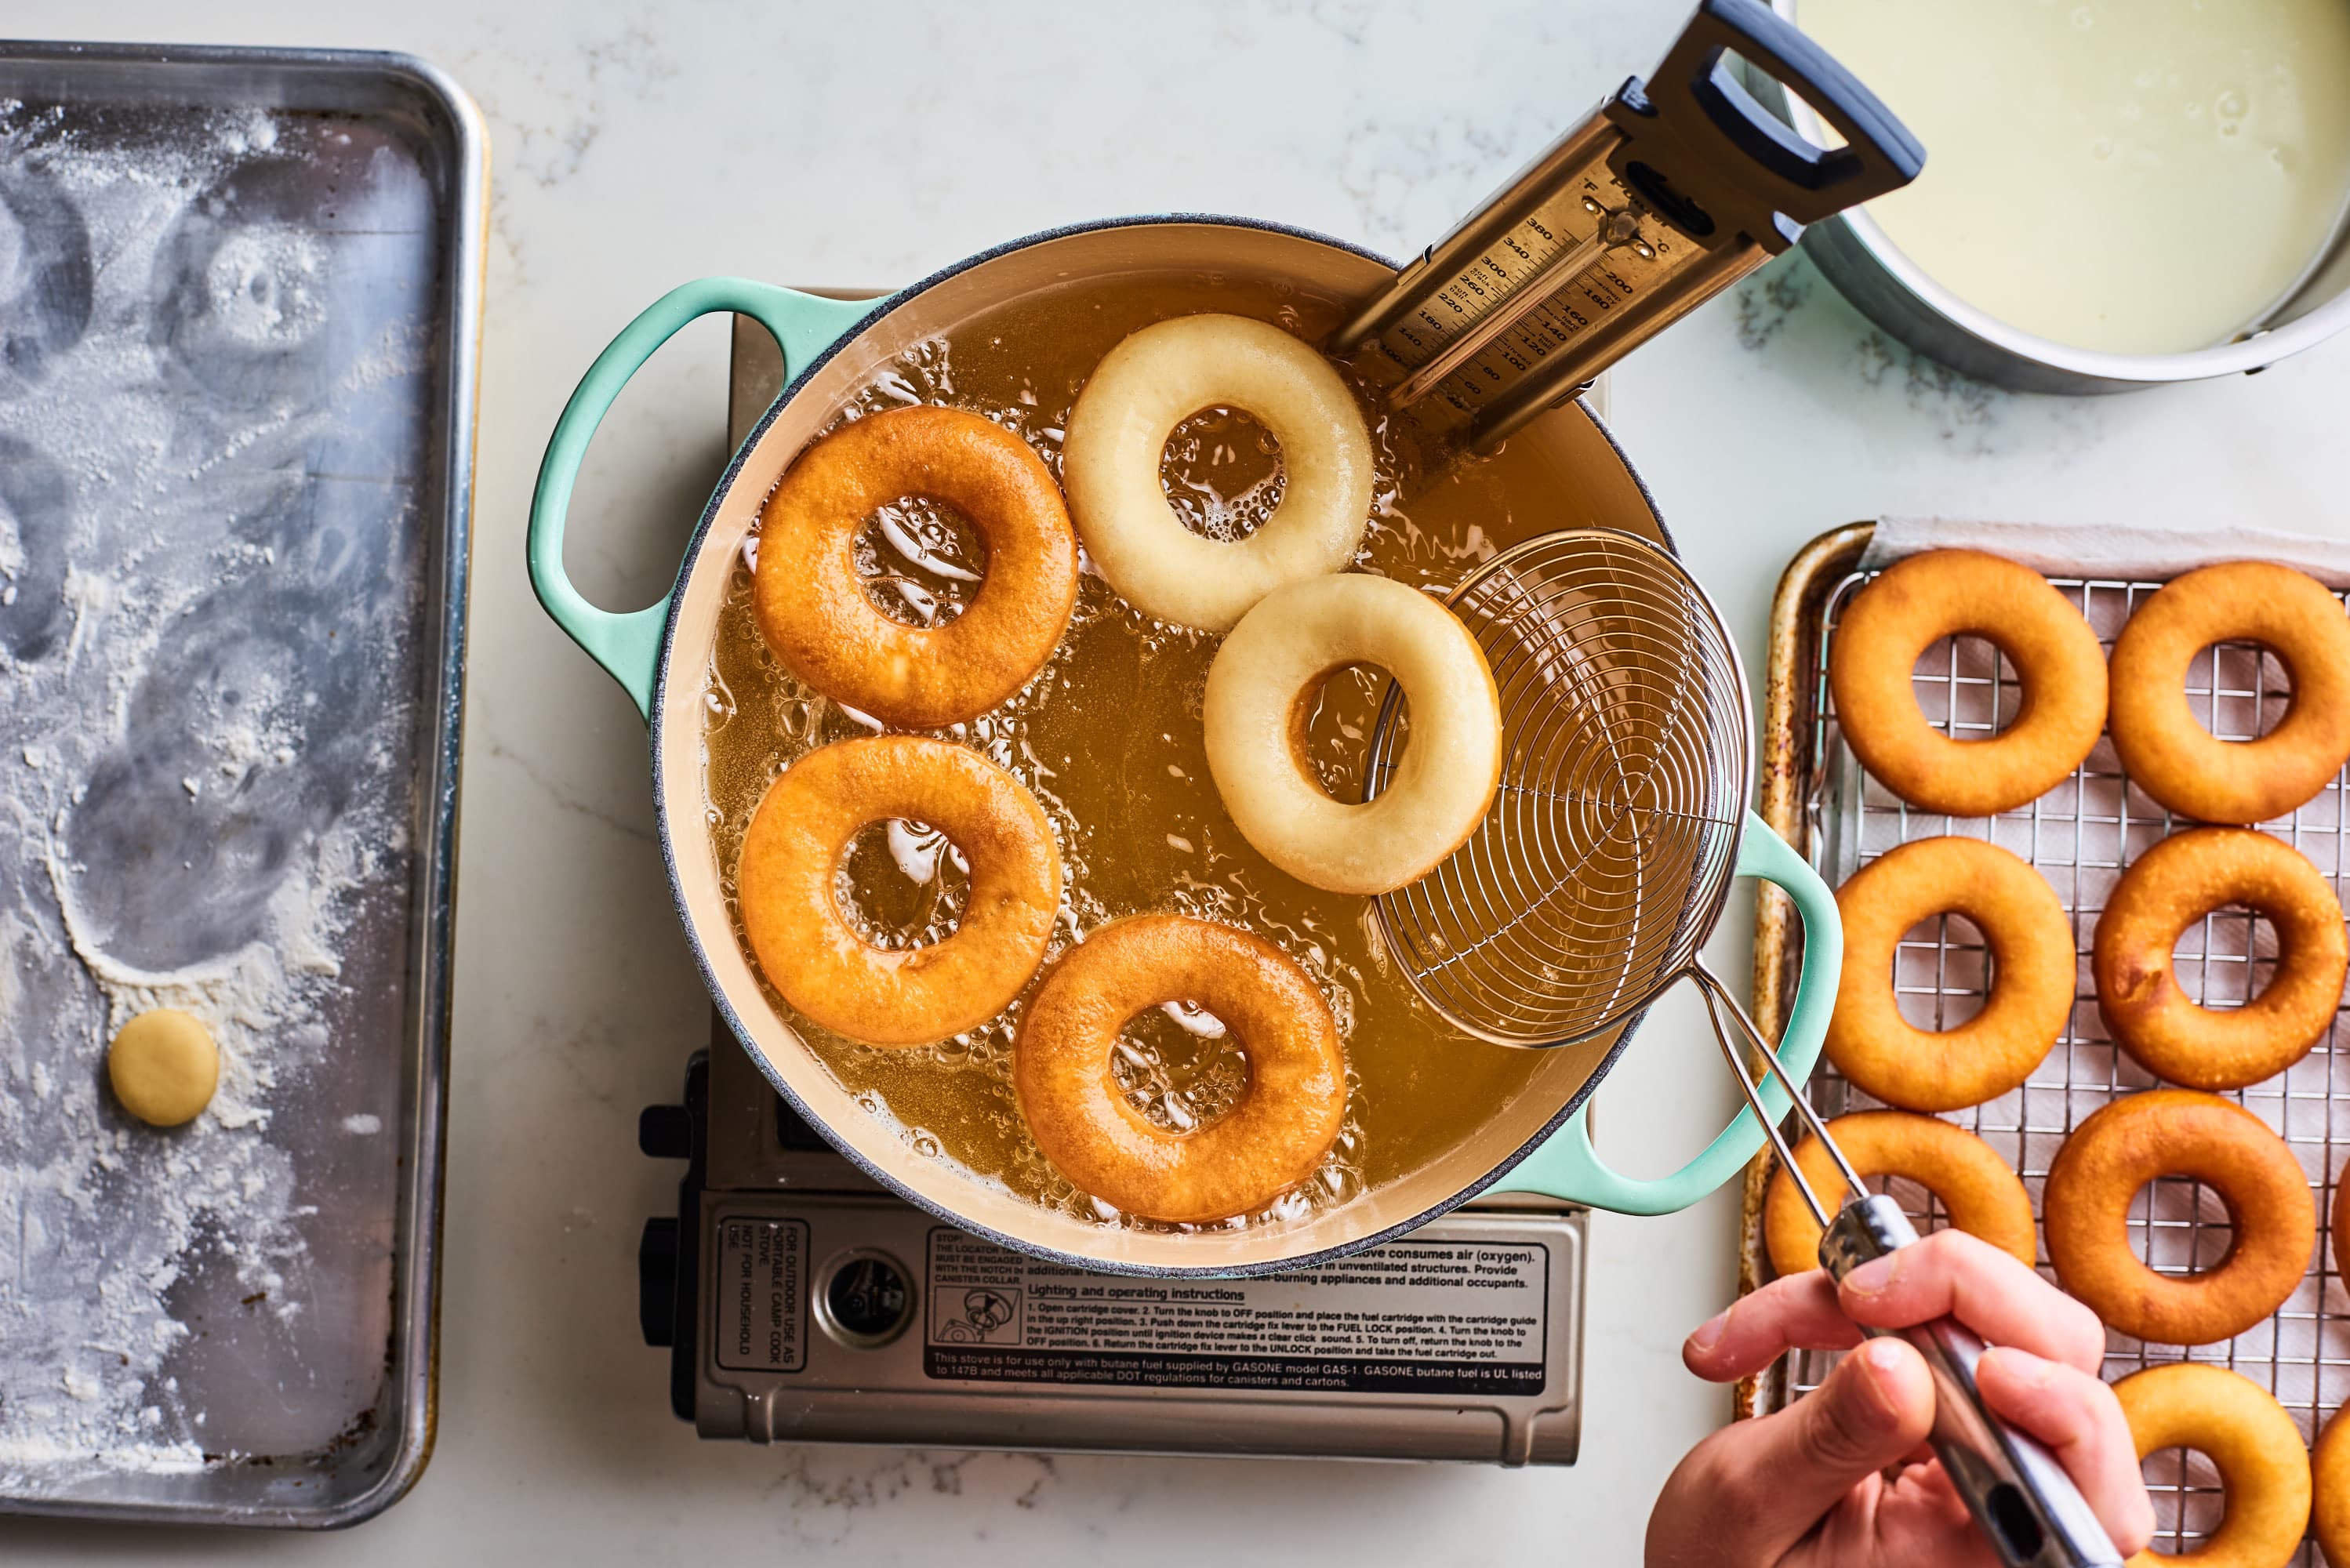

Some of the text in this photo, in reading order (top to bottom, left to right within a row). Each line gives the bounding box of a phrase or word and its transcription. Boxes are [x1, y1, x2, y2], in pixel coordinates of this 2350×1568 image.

[1527, 218, 1553, 240] 380
[1503, 238, 1529, 259] 340
[1481, 256, 1507, 278] 300
[1459, 275, 1484, 296] 260
[1606, 271, 1633, 293] 200
[1438, 292, 1463, 313] 220
[1584, 289, 1610, 309] 180
[1418, 310, 1442, 329] 180
[1562, 305, 1588, 325] 160
[1399, 327, 1422, 347] 140
[1542, 321, 1567, 341] 140
[1521, 336, 1546, 356] 120
[1502, 352, 1526, 371] 100
[1388, 1249, 1535, 1264] consumes air (oxygen).
[1338, 1260, 1407, 1272] unventilated
[1473, 1264, 1517, 1275] Provide
[739, 1225, 752, 1355] NOT FOR HOUSEHOLD
[1320, 1274, 1382, 1287] appliances
[1384, 1275, 1406, 1285] and
[1408, 1276, 1463, 1287] additional
[769, 1226, 783, 1363] PORTABLE CAMP COOK
[783, 1227, 797, 1363] FOR OUTDOOR USE AS
[1027, 1285, 1244, 1300] Lighting and operating instructions
[1037, 1304, 1063, 1314] Open
[1066, 1305, 1109, 1315] cartridge
[1193, 1308, 1219, 1316] knob
[1255, 1309, 1293, 1320] position
[1316, 1311, 1342, 1321] place
[1343, 1312, 1359, 1320] the
[1381, 1313, 1424, 1323] cartridge
[1465, 1315, 1508, 1326] cartridge
[1509, 1316, 1537, 1327] guide
[1044, 1327, 1088, 1335] IGNITION
[1090, 1328, 1129, 1338] position
[1154, 1330, 1191, 1340] ignition
[1193, 1330, 1225, 1339] device
[1226, 1331, 1257, 1340] makes
[1420, 1337, 1449, 1345] return
[1070, 1316, 1093, 1326] right
[1150, 1318, 1174, 1327] Push
[1176, 1319, 1203, 1327] down
[1204, 1319, 1221, 1328] the
[1222, 1320, 1266, 1330] cartridge
[1490, 1327, 1514, 1336] knob
[1026, 1337, 1045, 1345] OFF
[1103, 1339, 1135, 1348] Return
[1155, 1341, 1198, 1352] cartridge
[1214, 1342, 1237, 1351] lever
[1269, 1344, 1311, 1353] UNLOCK
[1313, 1345, 1353, 1356] position
[1375, 1347, 1396, 1356] take
[1434, 1349, 1477, 1359] cartridge
[935, 1352, 957, 1363] This
[961, 1353, 990, 1363] stove
[1006, 1355, 1020, 1364] for
[1047, 1356, 1070, 1368] only
[1074, 1357, 1097, 1367] with
[1100, 1358, 1139, 1368] butane
[1142, 1359, 1162, 1369] fuel
[1166, 1359, 1212, 1372] supplied
[1232, 1361, 1281, 1372] GASONE
[1285, 1363, 1319, 1373] model
[1364, 1365, 1413, 1376] GASONE
[1415, 1367, 1455, 1377] butane
[1457, 1368, 1477, 1377] fuel
[1493, 1369, 1508, 1378] UL
[1511, 1370, 1542, 1379] listed
[951, 1365, 978, 1375] 147B
[980, 1366, 1001, 1376] and
[1004, 1367, 1037, 1377] meets
[1041, 1368, 1054, 1377] all
[1056, 1368, 1113, 1381] applicable
[1116, 1370, 1139, 1380] DOT
[1143, 1371, 1206, 1384] regulations
[1208, 1373, 1224, 1382] for
[1227, 1374, 1278, 1385] canisters
[1280, 1375, 1302, 1385] and
